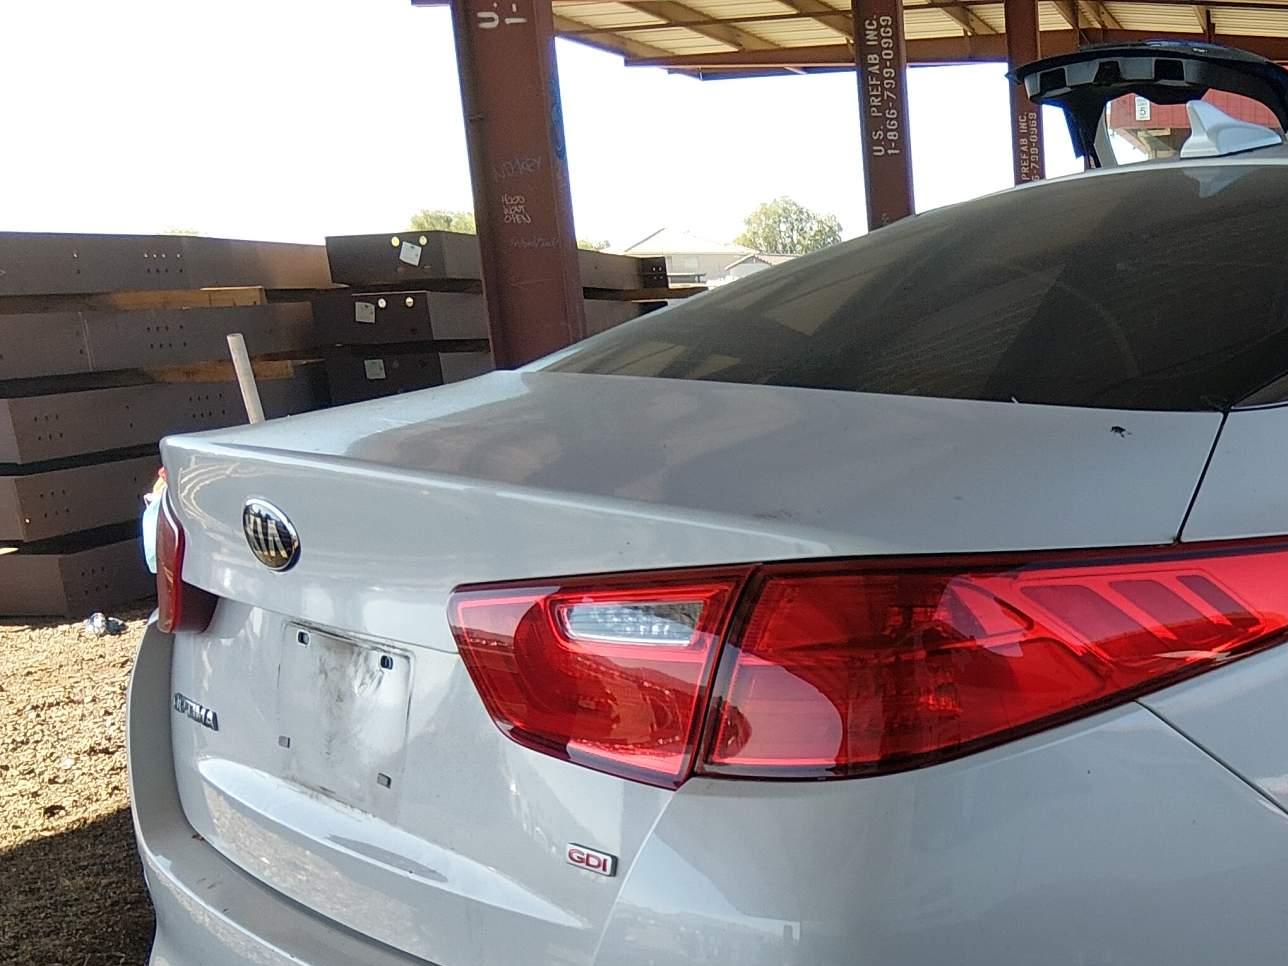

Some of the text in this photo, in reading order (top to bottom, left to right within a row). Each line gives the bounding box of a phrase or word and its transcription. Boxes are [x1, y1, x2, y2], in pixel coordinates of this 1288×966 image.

[865, 15, 884, 157] U.S. PREFAB INC.
[879, 15, 900, 155] 1-866-799-0969
[1019, 138, 1030, 181] PREFAB
[568, 848, 608, 872] GDI
